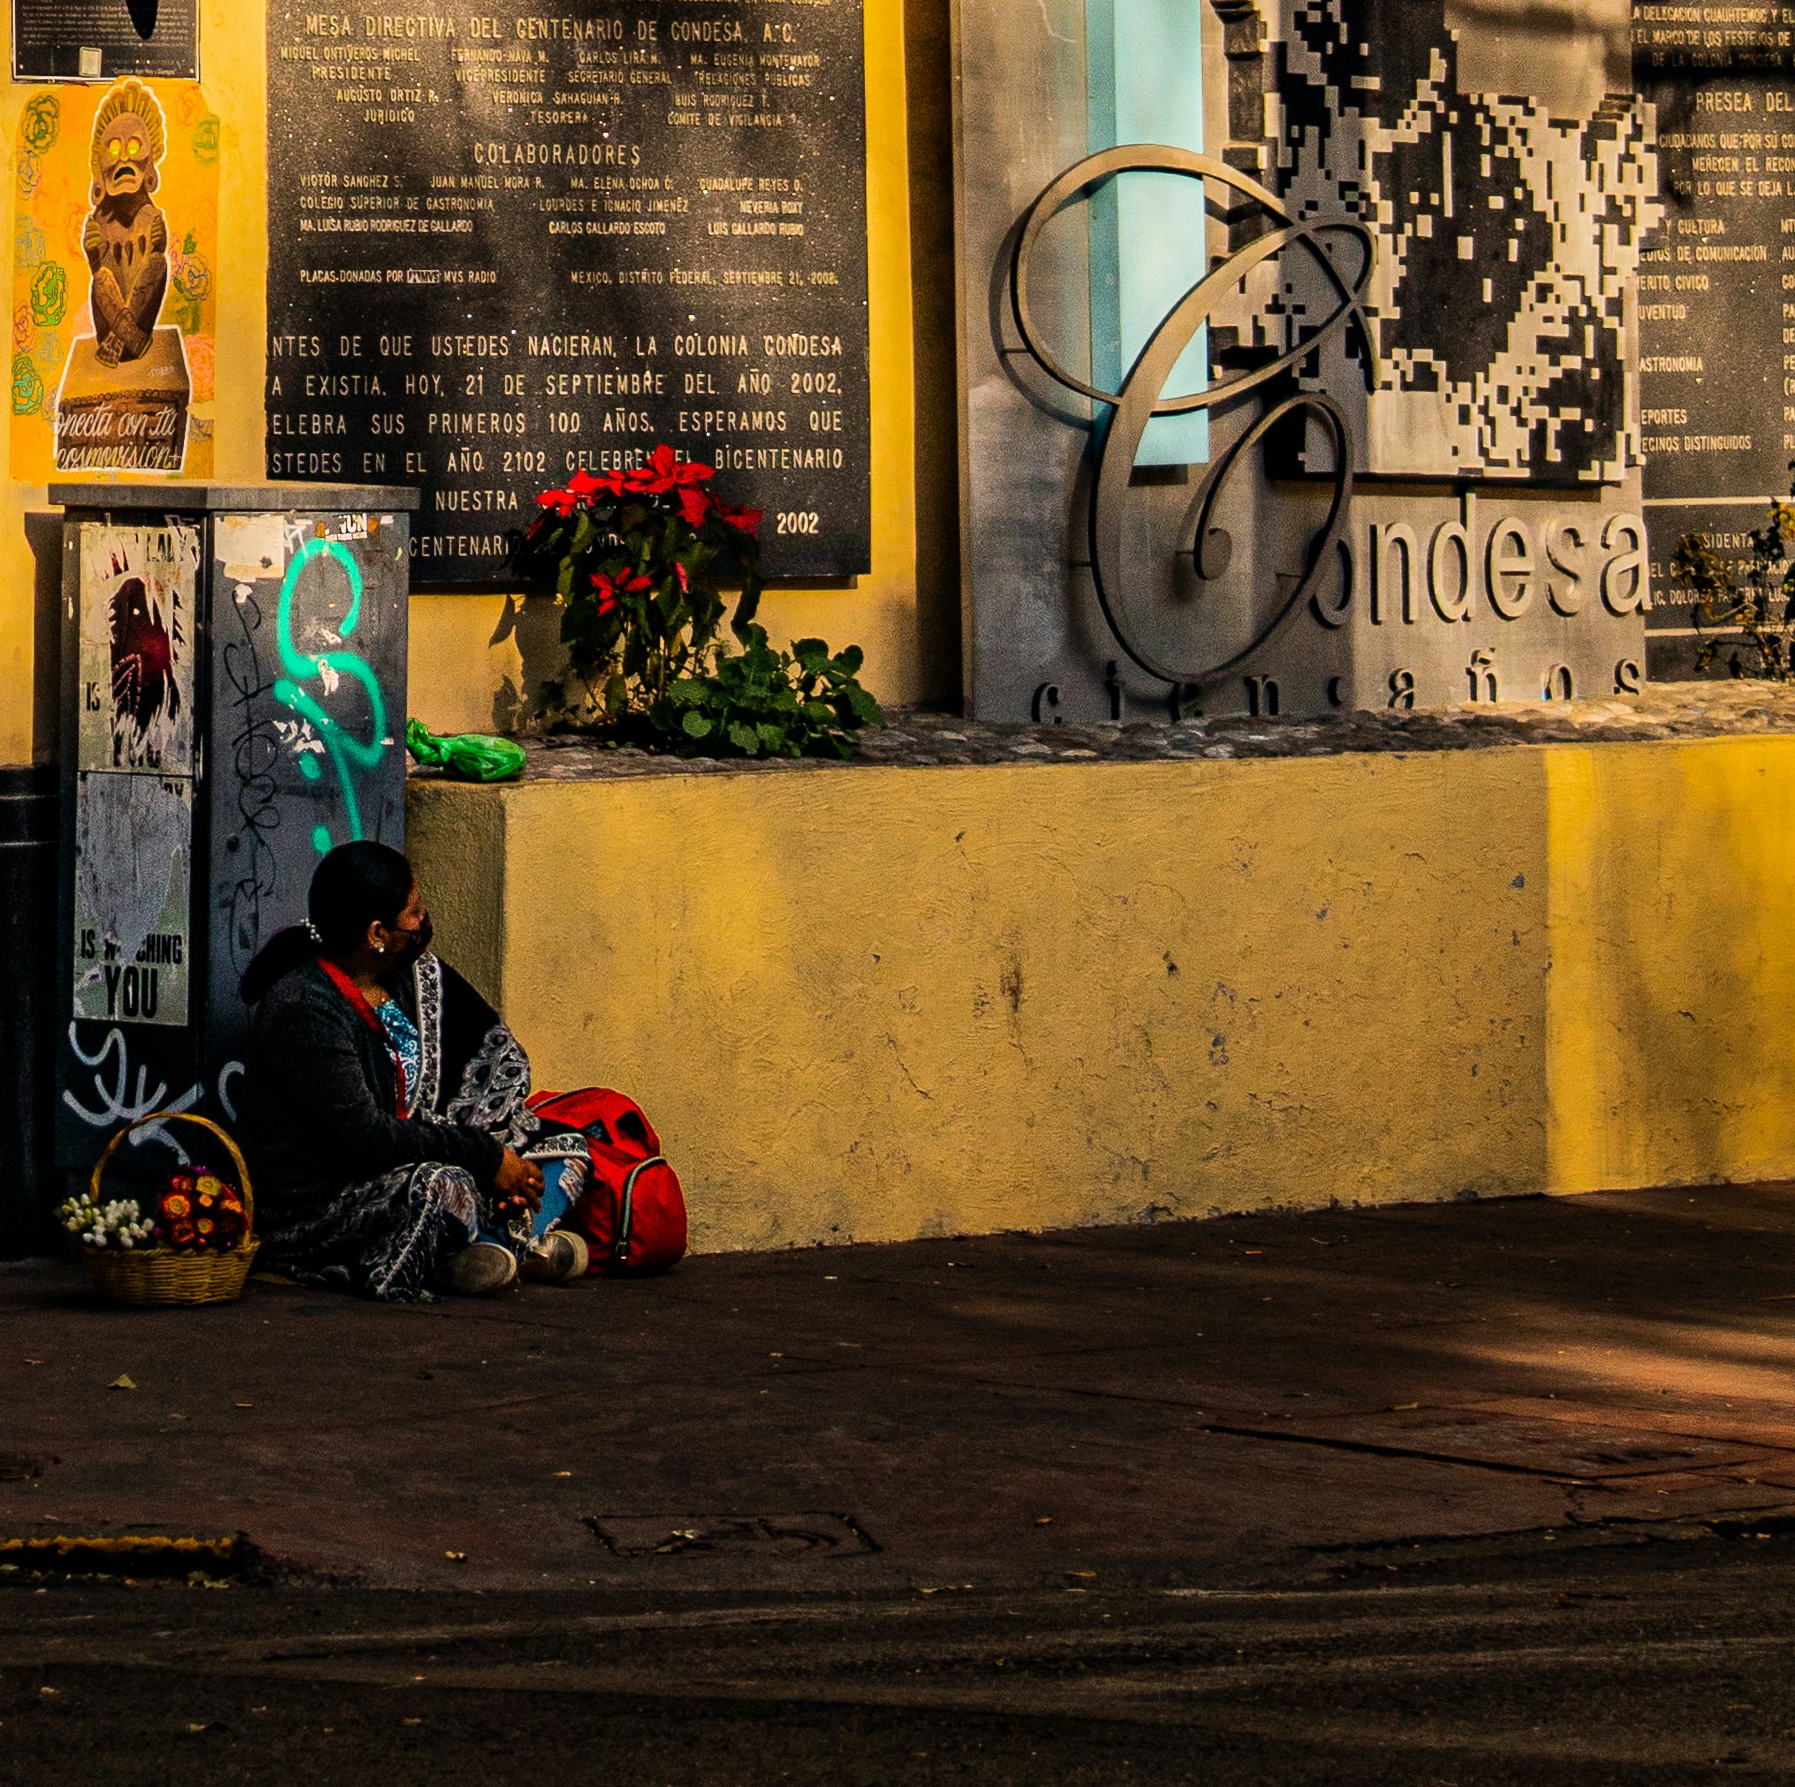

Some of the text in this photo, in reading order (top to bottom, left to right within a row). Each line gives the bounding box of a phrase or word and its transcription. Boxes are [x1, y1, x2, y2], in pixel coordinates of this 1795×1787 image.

[306, 14, 624, 41] MESA DIRECTIVA DEL CENTENARIO
[1695, 91, 1753, 113] PRESEA
[473, 142, 642, 166] COLABORADORES
[339, 335, 363, 357] DE
[379, 335, 413, 357] QUE
[430, 334, 509, 357] USTEDES
[634, 335, 658, 357] LA
[673, 334, 748, 357] COLONIA
[764, 334, 843, 357] CONDESA
[465, 374, 485, 396] 21
[503, 373, 526, 396] DE
[545, 370, 665, 396] SEPTIEMBRE
[736, 367, 772, 396] AÑO
[54, 399, 113, 438] onecta
[117, 411, 149, 438] con
[370, 413, 406, 436] SUS
[427, 412, 527, 435] PRIMEROS
[548, 411, 582, 435] 100
[678, 410, 788, 433] ESPERAMOS
[808, 409, 843, 432] QUE
[1009, 142, 1653, 686] Condesa
[362, 446, 547, 474] EN EL AÑO 2102
[714, 447, 844, 470] BICENTENARIO
[435, 490, 519, 512] NUESTRA
[775, 511, 820, 535] 2002
[80, 928, 183, 966] IS WCHING
[105, 965, 159, 1019] YOU
